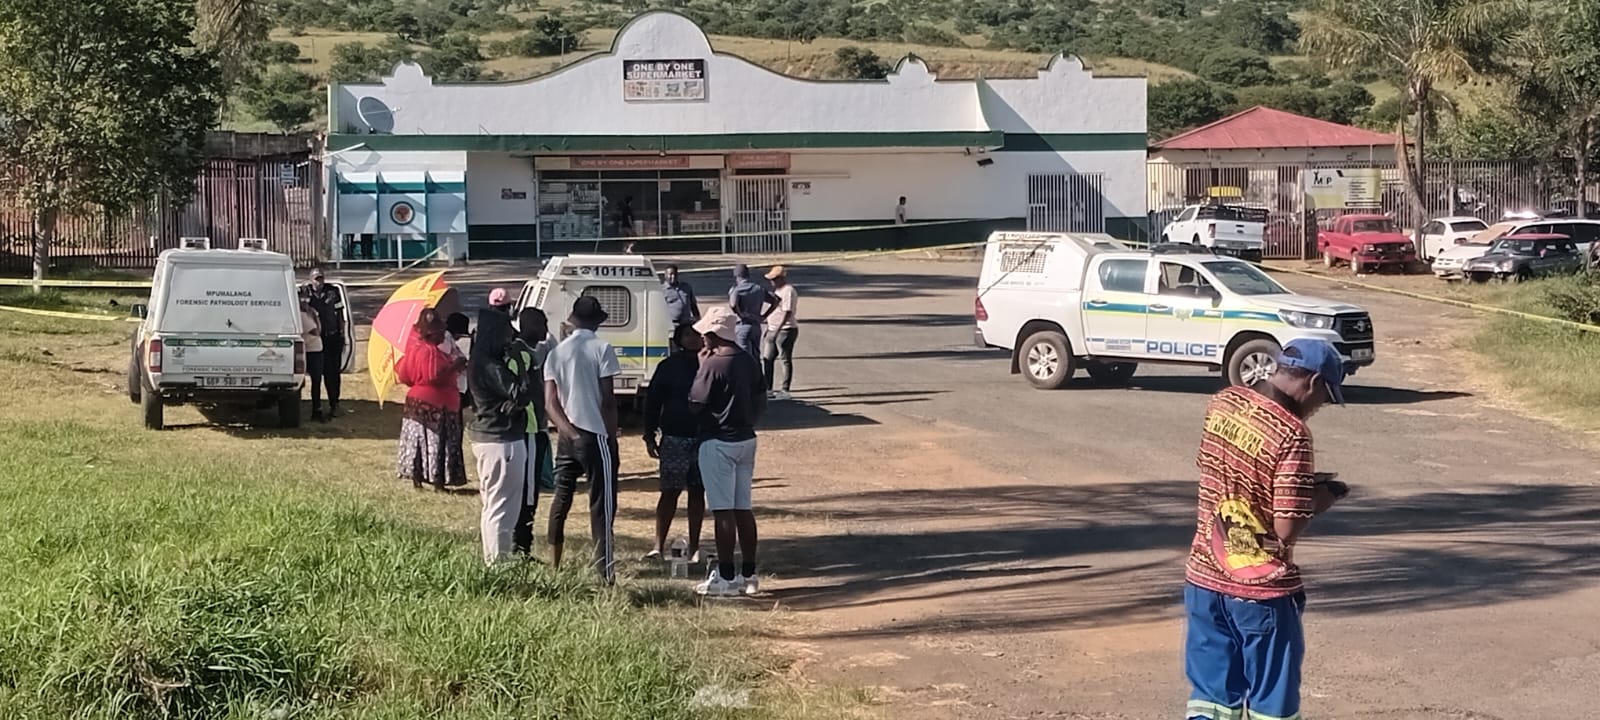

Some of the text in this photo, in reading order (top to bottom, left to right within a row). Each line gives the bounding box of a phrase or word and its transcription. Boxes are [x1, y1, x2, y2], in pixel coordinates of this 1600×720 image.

[633, 63, 655, 71] ONE
[673, 63, 695, 71] ONE
[626, 71, 702, 79] SUPERMARKET
[593, 266, 633, 276] 10111
[1146, 341, 1217, 357] POLICE
